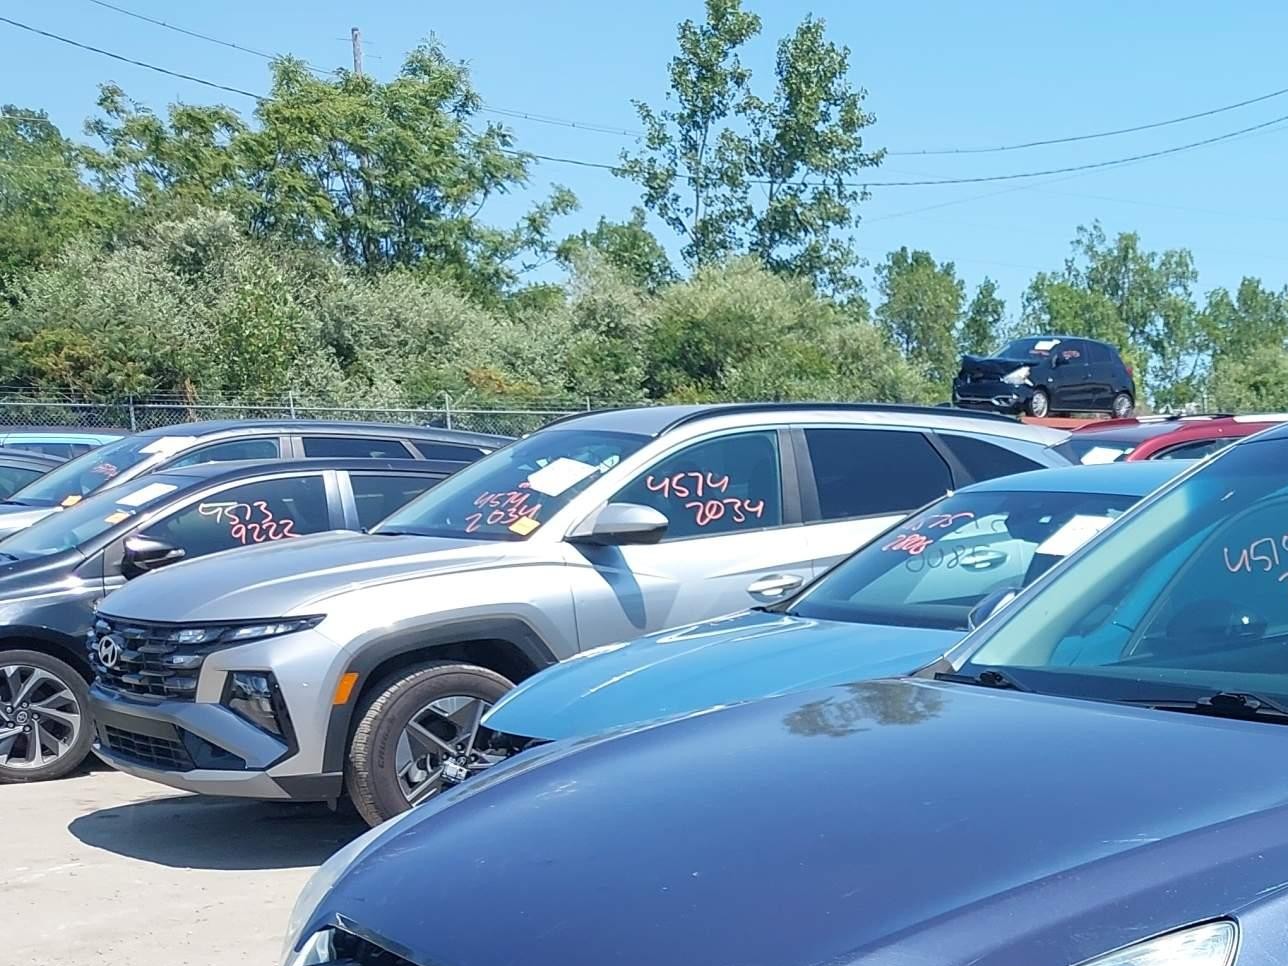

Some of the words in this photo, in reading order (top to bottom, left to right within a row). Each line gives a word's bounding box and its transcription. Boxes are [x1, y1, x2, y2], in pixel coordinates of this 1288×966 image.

[646, 471, 729, 498] 4574
[198, 501, 273, 525] 4573
[473, 491, 530, 509] 4574
[685, 498, 764, 525] 2034
[465, 503, 542, 533] 2034
[231, 519, 302, 545] 9222
